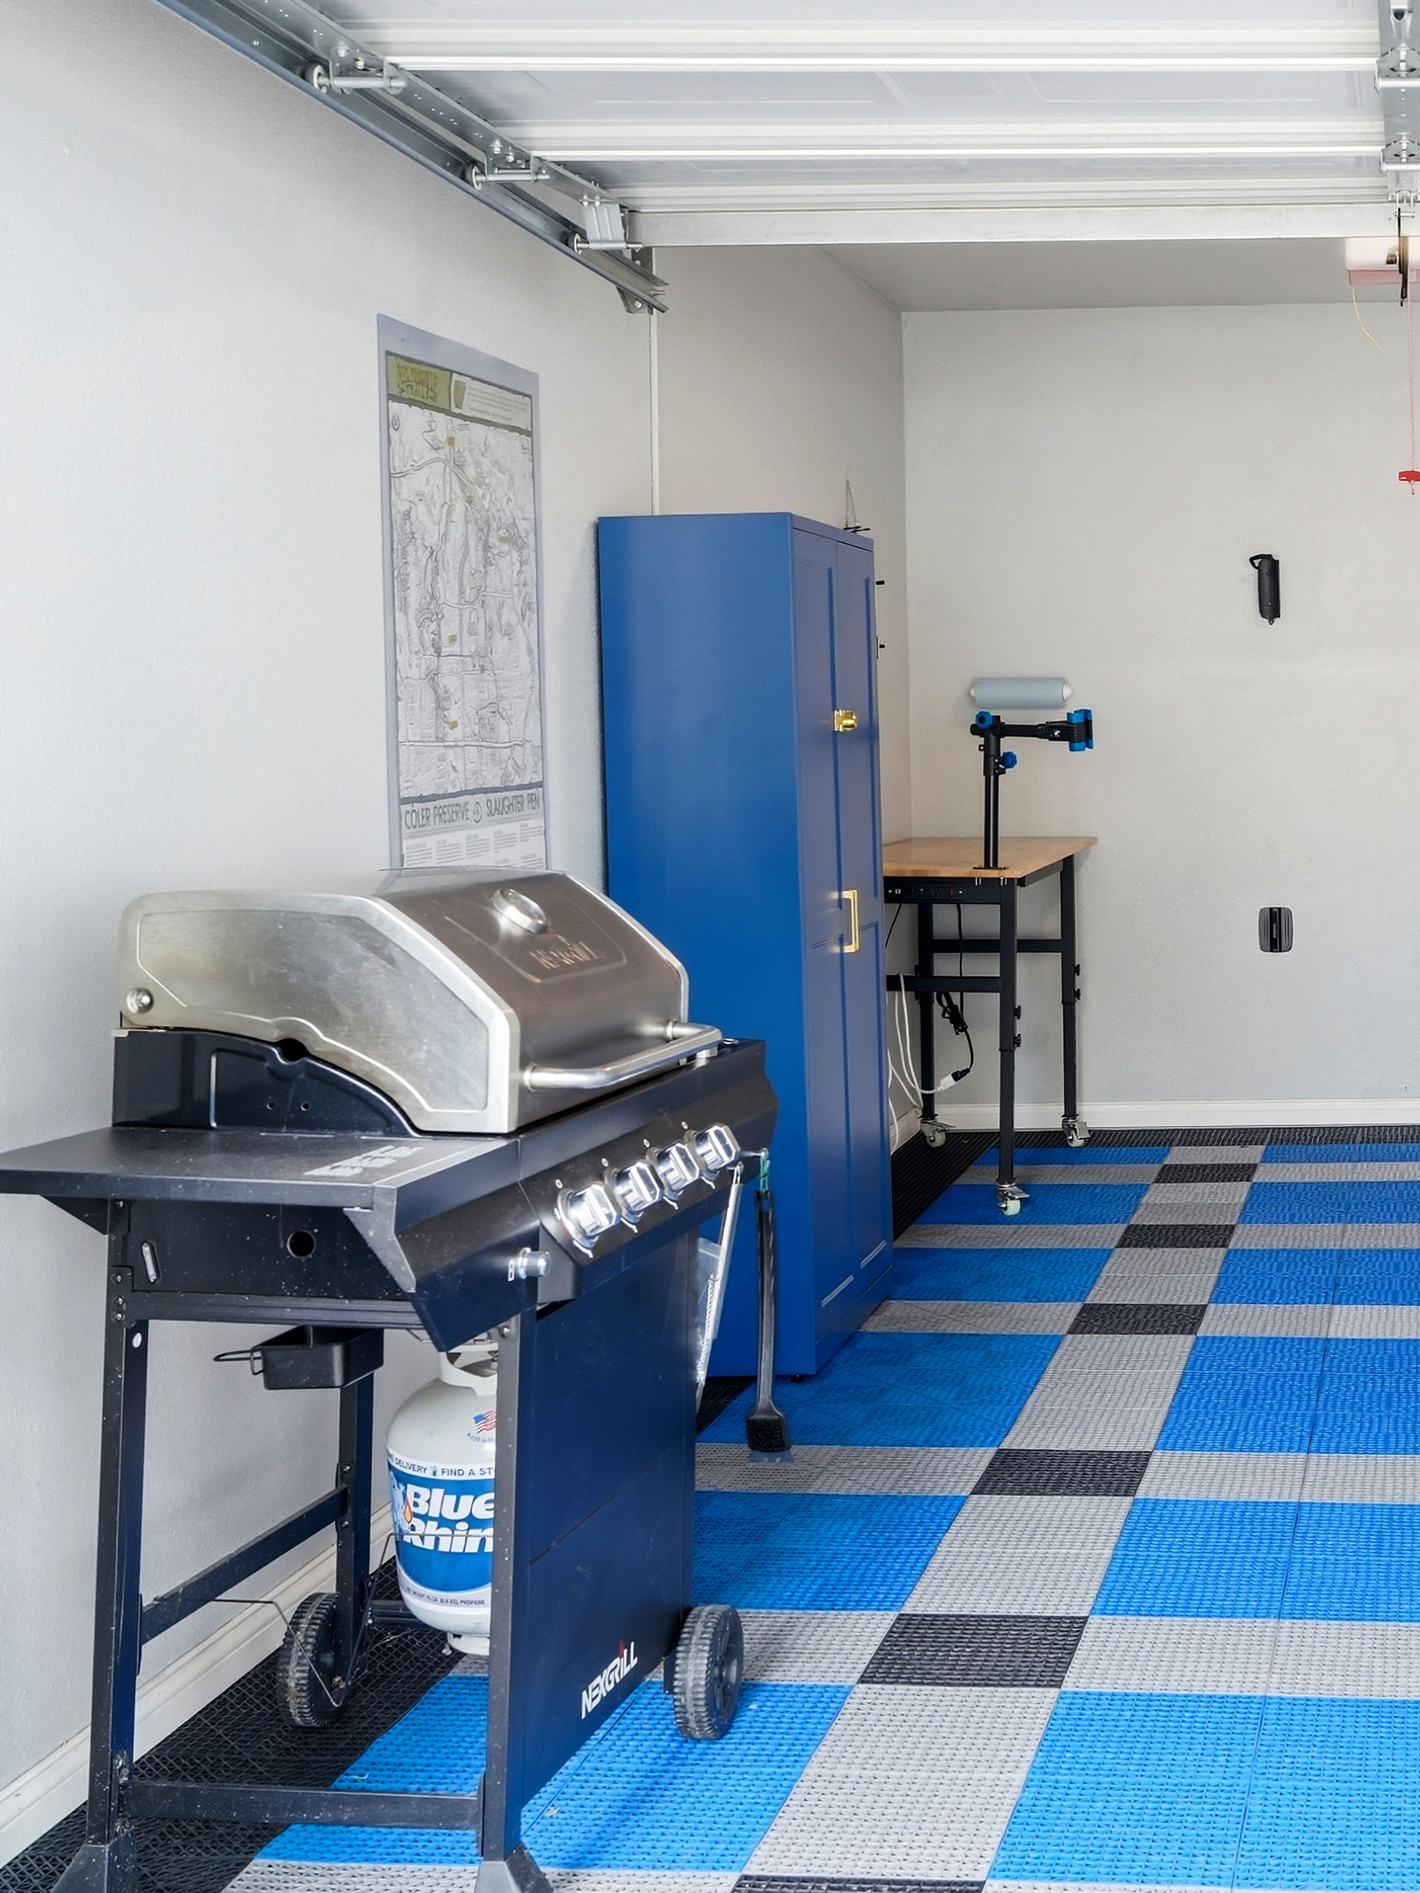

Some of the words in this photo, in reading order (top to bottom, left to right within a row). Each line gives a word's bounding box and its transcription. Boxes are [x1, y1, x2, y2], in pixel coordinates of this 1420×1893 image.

[404, 806, 431, 830] COLER
[433, 801, 470, 827] PRESERVE
[485, 795, 525, 818] SLAUGHTER
[526, 791, 540, 811] PEN
[395, 1457, 428, 1474] DELIVERY
[441, 1468, 465, 1477] FIND
[468, 1468, 476, 1476] A
[479, 1467, 493, 1476] ST
[407, 1483, 495, 1520] Blue
[403, 1517, 494, 1553] Rhin
[581, 1641, 638, 1720] NEXGRILL
